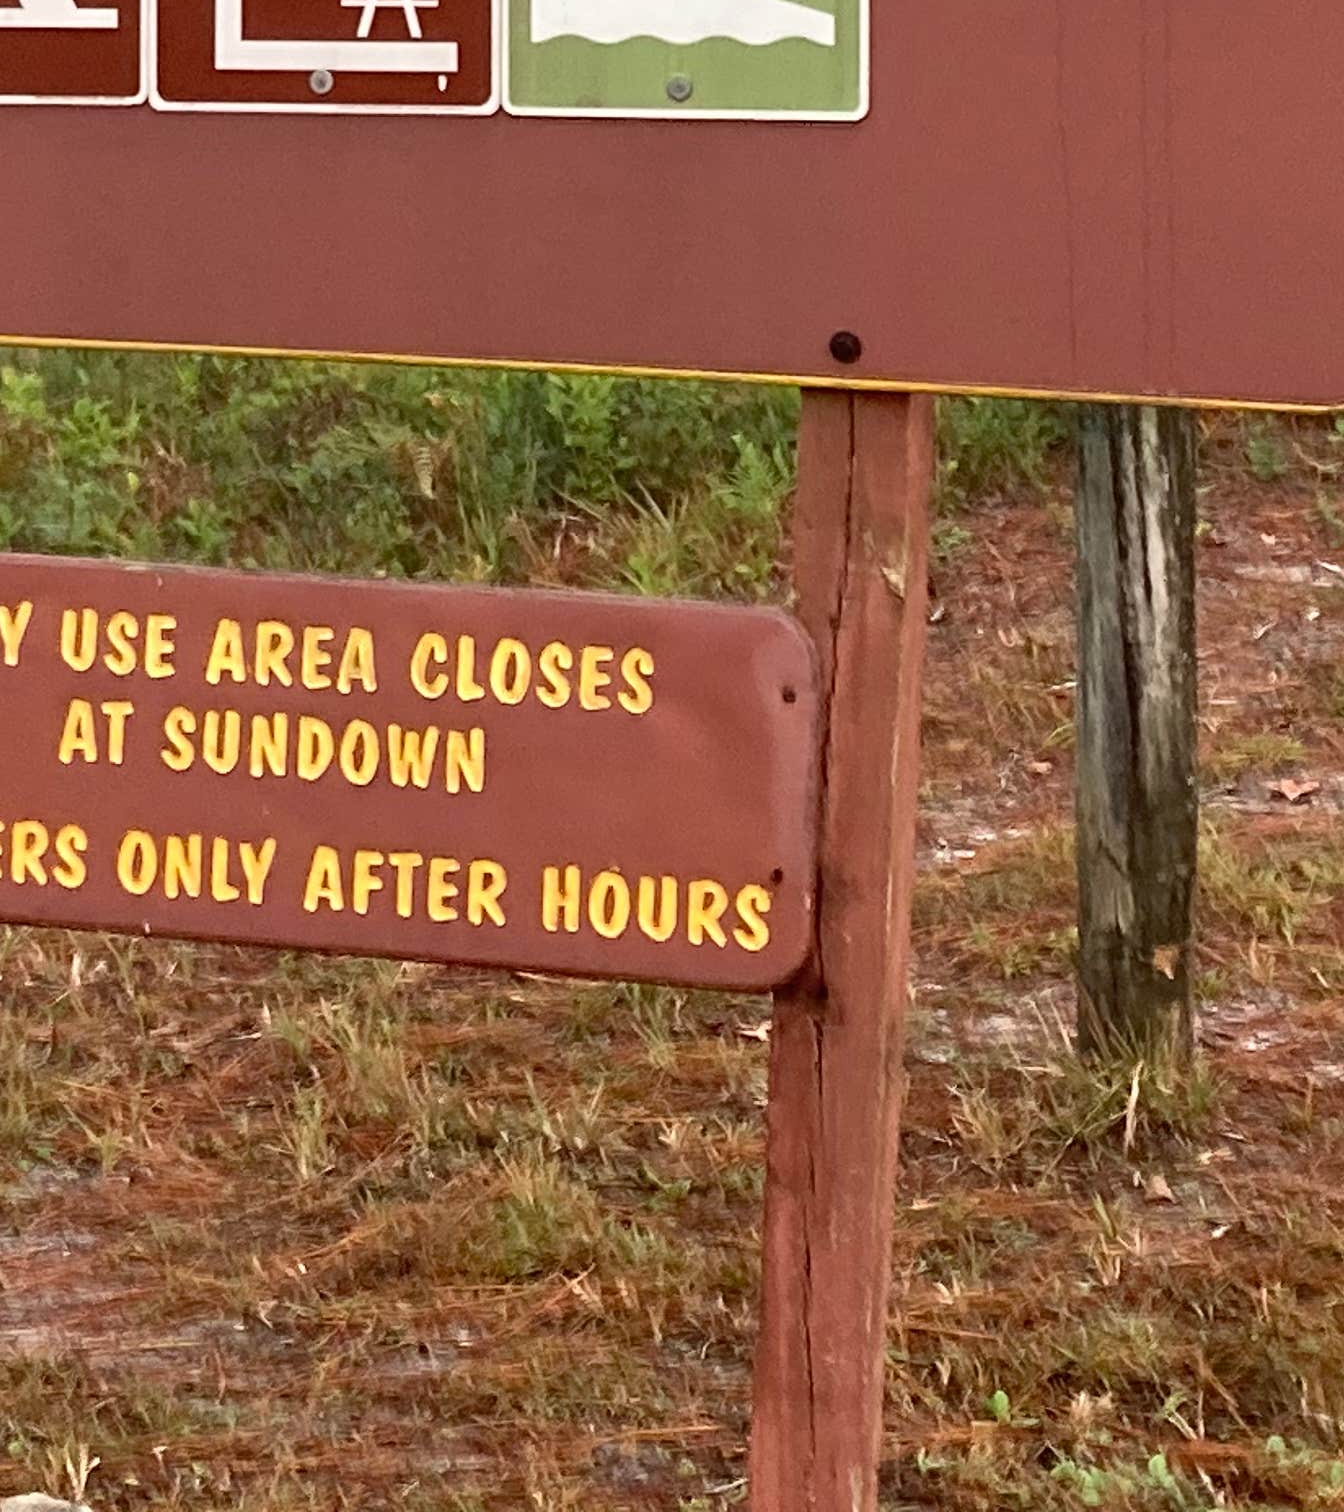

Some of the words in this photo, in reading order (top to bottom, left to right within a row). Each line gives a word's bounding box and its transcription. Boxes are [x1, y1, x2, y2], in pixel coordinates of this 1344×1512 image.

[60, 608, 176, 679] USE
[205, 618, 377, 693] AREA
[410, 632, 654, 714] CLOSES
[58, 698, 134, 764] AT
[160, 706, 485, 793] SUNDOWN
[116, 830, 277, 904] ONLY
[303, 845, 507, 925] AFTER
[541, 865, 771, 952] HOURS
